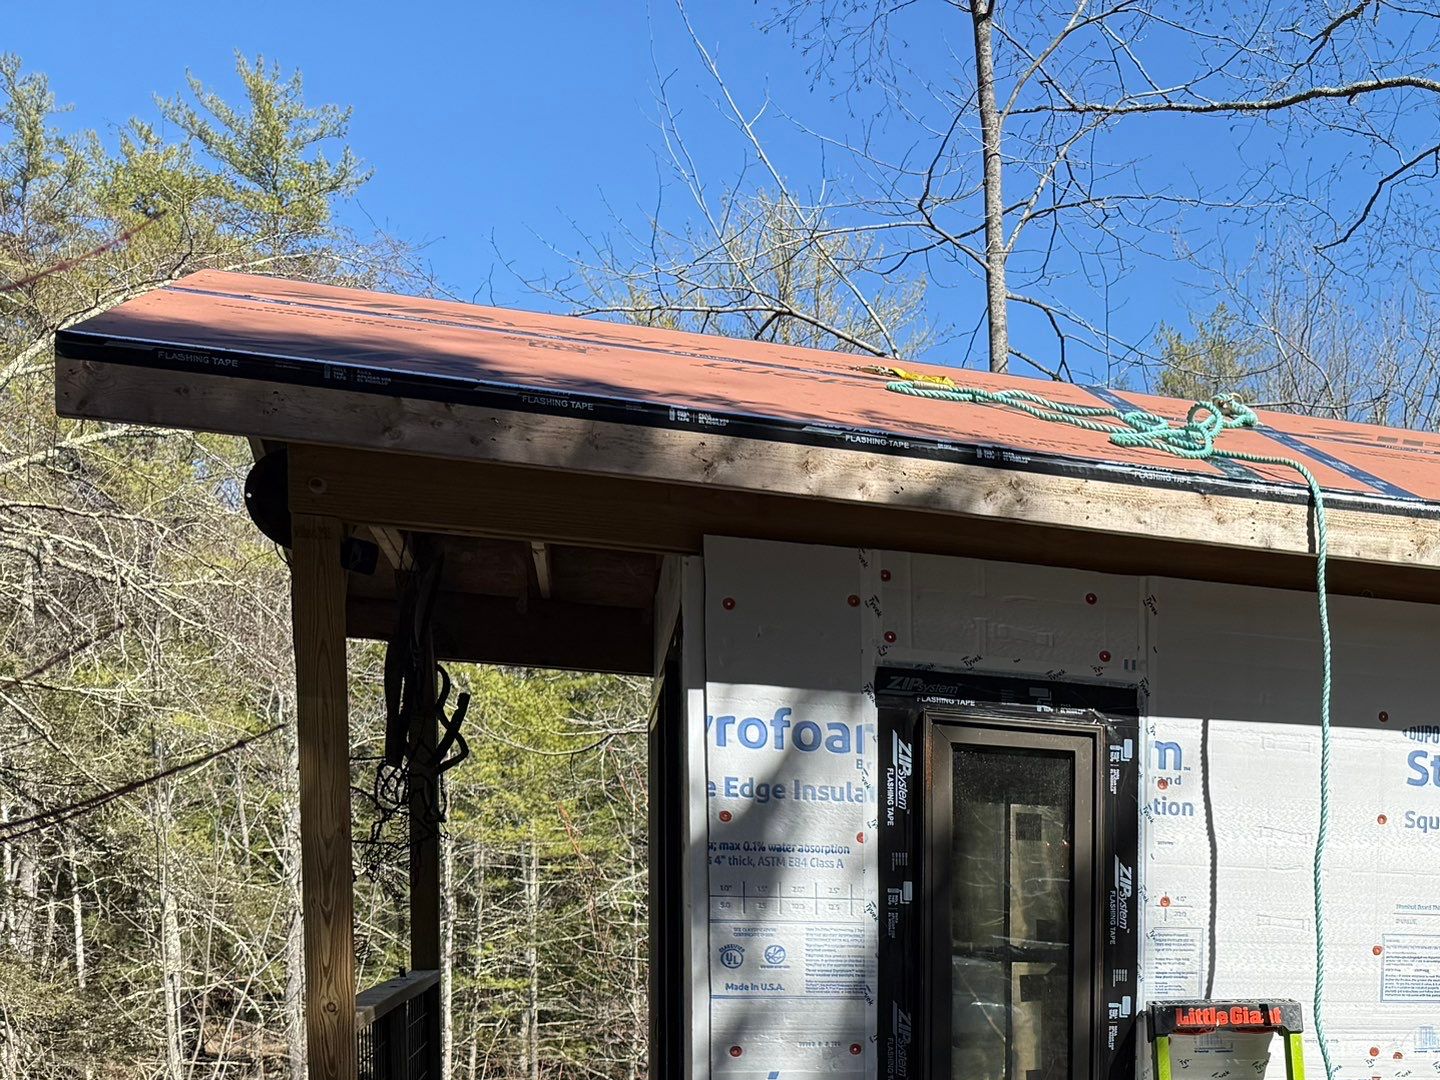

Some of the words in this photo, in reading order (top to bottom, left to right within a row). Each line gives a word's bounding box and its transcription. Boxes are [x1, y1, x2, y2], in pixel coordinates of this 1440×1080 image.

[157, 351, 210, 365] FLASHING
[211, 356, 239, 368] TAPE
[522, 395, 568, 408] FLASHING
[570, 400, 594, 411] TAPE
[845, 434, 886, 447] FLASHING
[888, 438, 910, 449] TAPE
[1173, 475, 1192, 484] TAPE
[865, 594, 882, 618] Tyvek
[961, 653, 983, 668] Tyvek
[957, 698, 976, 707] TAPE
[724, 777, 786, 803] Edge
[887, 767, 895, 805] FLASHING
[887, 807, 895, 826] TAPE
[719, 841, 744, 851] max
[745, 841, 766, 851] 0.1%
[768, 844, 795, 853] water
[798, 843, 850, 856] absorption
[728, 856, 756, 868] thick,
[758, 858, 785, 867] ASTM
[788, 858, 808, 868] E84
[810, 858, 834, 868] Class
[836, 860, 844, 868] A
[865, 901, 878, 921] Tyvek
[725, 982, 750, 991] Made
[761, 983, 785, 991] U.S.A.
[1176, 1007, 1228, 1026] Little
